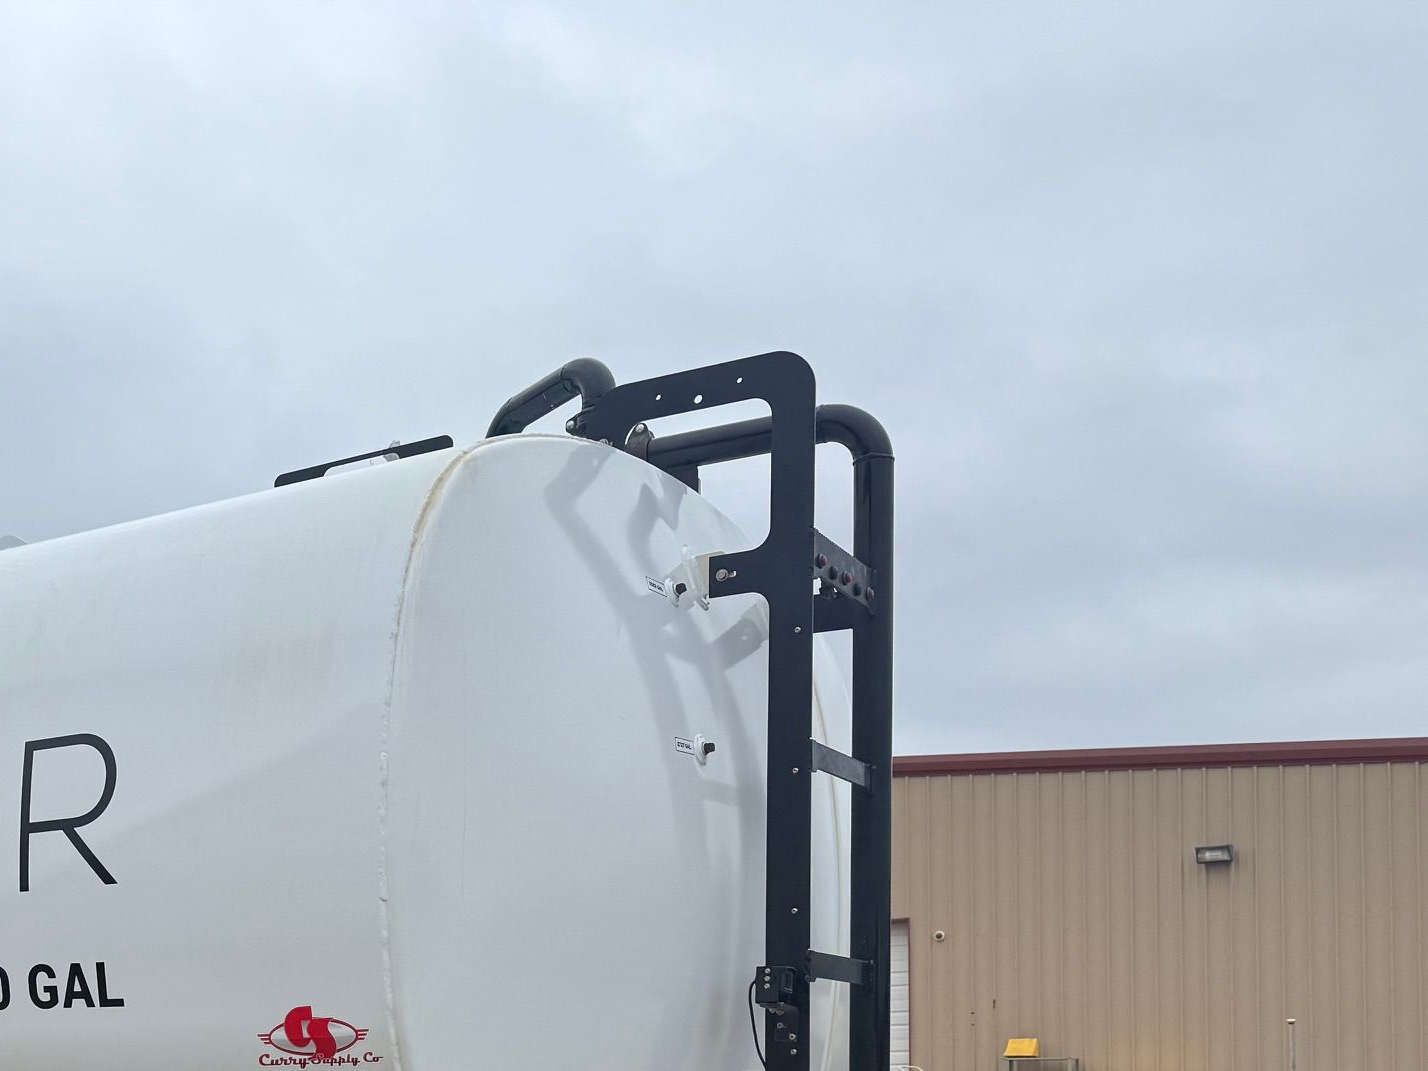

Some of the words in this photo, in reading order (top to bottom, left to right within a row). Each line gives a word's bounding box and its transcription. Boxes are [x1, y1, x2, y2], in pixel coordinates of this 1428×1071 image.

[27, 961, 125, 1009] GAL
[258, 1053, 309, 1070] Curry
[309, 1053, 361, 1067] Supply
[363, 1051, 384, 1063] Co
